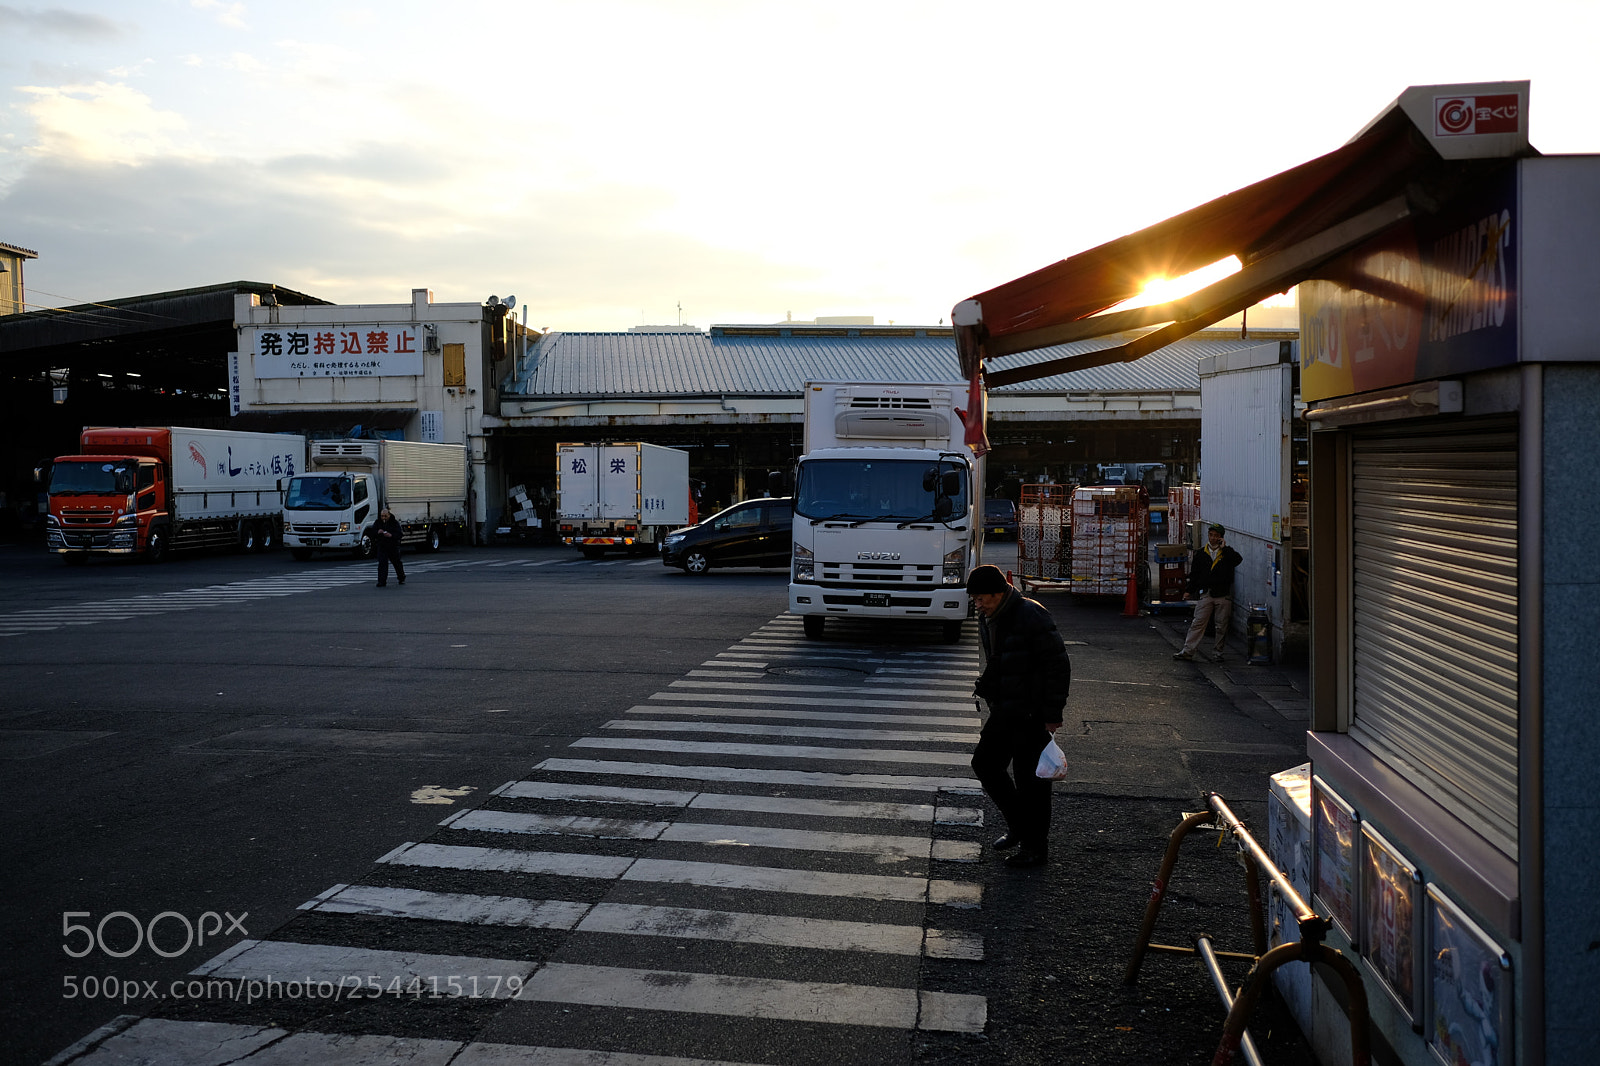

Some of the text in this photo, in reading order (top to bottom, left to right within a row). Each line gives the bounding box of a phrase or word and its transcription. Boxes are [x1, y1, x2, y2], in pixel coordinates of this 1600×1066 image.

[1475, 104, 1518, 121] 宝くじ
[260, 329, 416, 356] 発泡持込禁止
[857, 551, 901, 561] ISUZU
